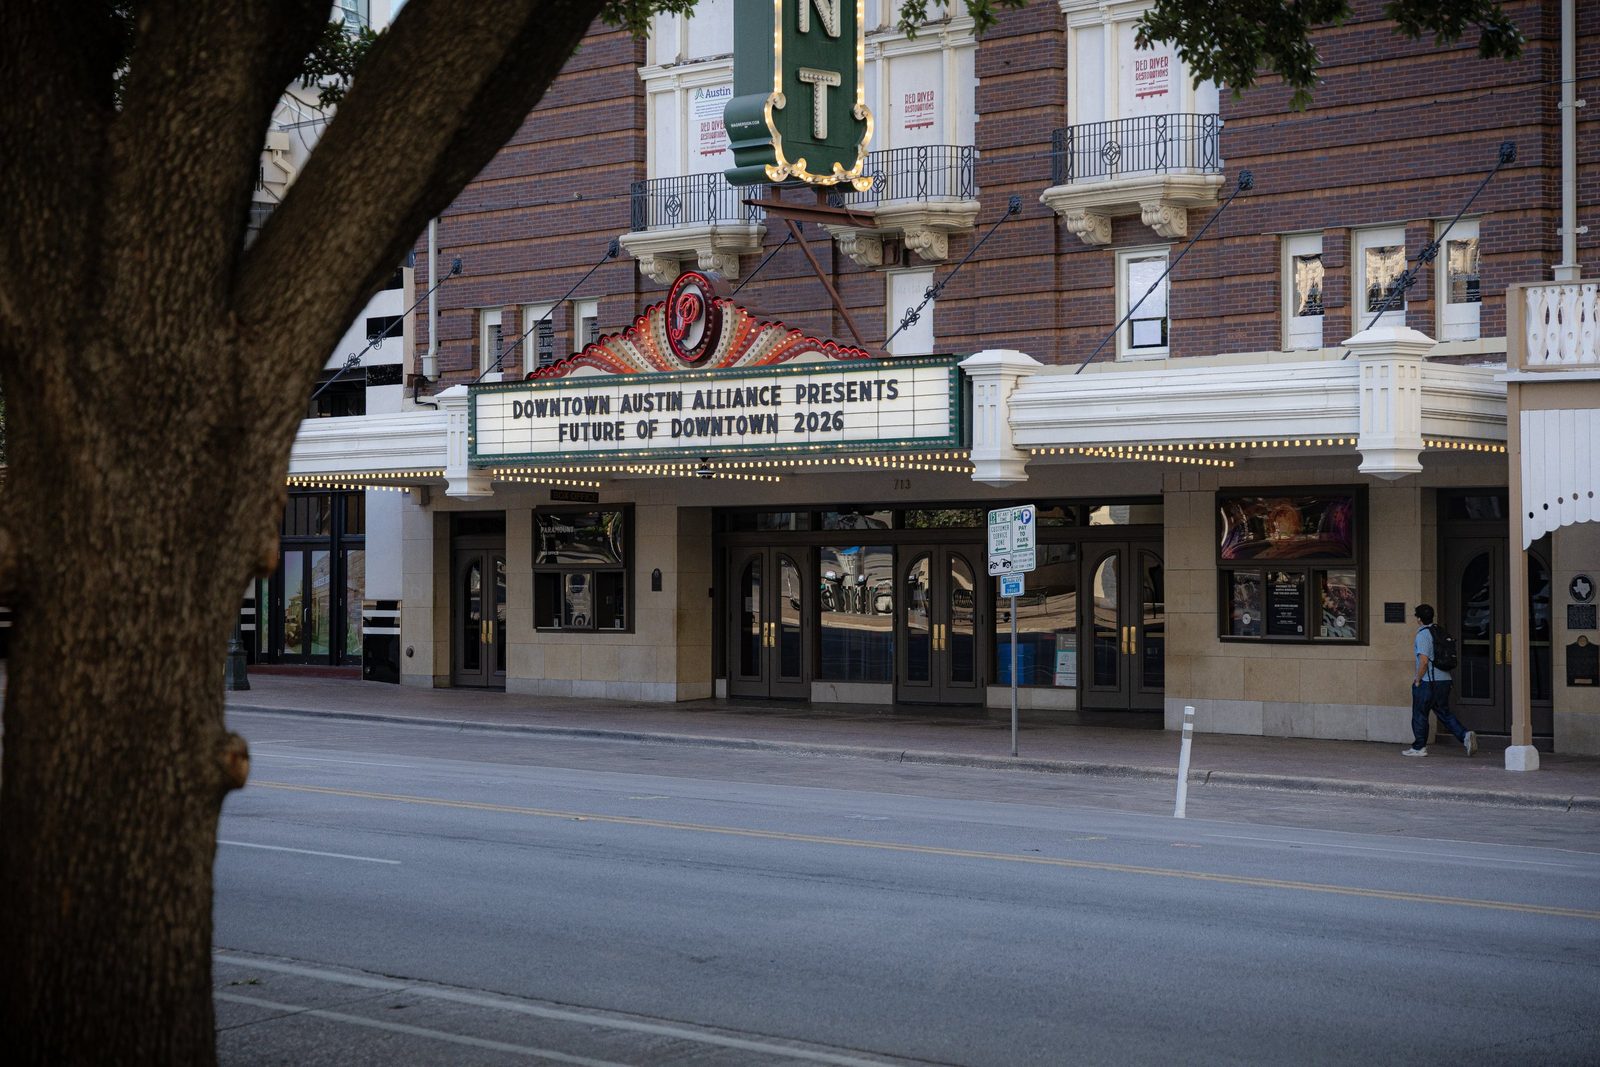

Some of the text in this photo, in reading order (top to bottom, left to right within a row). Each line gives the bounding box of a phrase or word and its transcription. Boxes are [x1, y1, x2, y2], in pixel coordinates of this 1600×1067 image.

[1136, 56, 1168, 71] RED RIVER
[705, 86, 731, 98] Austin
[904, 91, 934, 104] RED RIVER
[513, 379, 898, 419] DOWNTOWN AUSTIN ALLIANCE PRESENTS
[559, 411, 844, 442] FUTURE OF DOWNTOWN 2026
[541, 525, 574, 533] PARAMOUNT
[991, 525, 1009, 533] CUSTOMER
